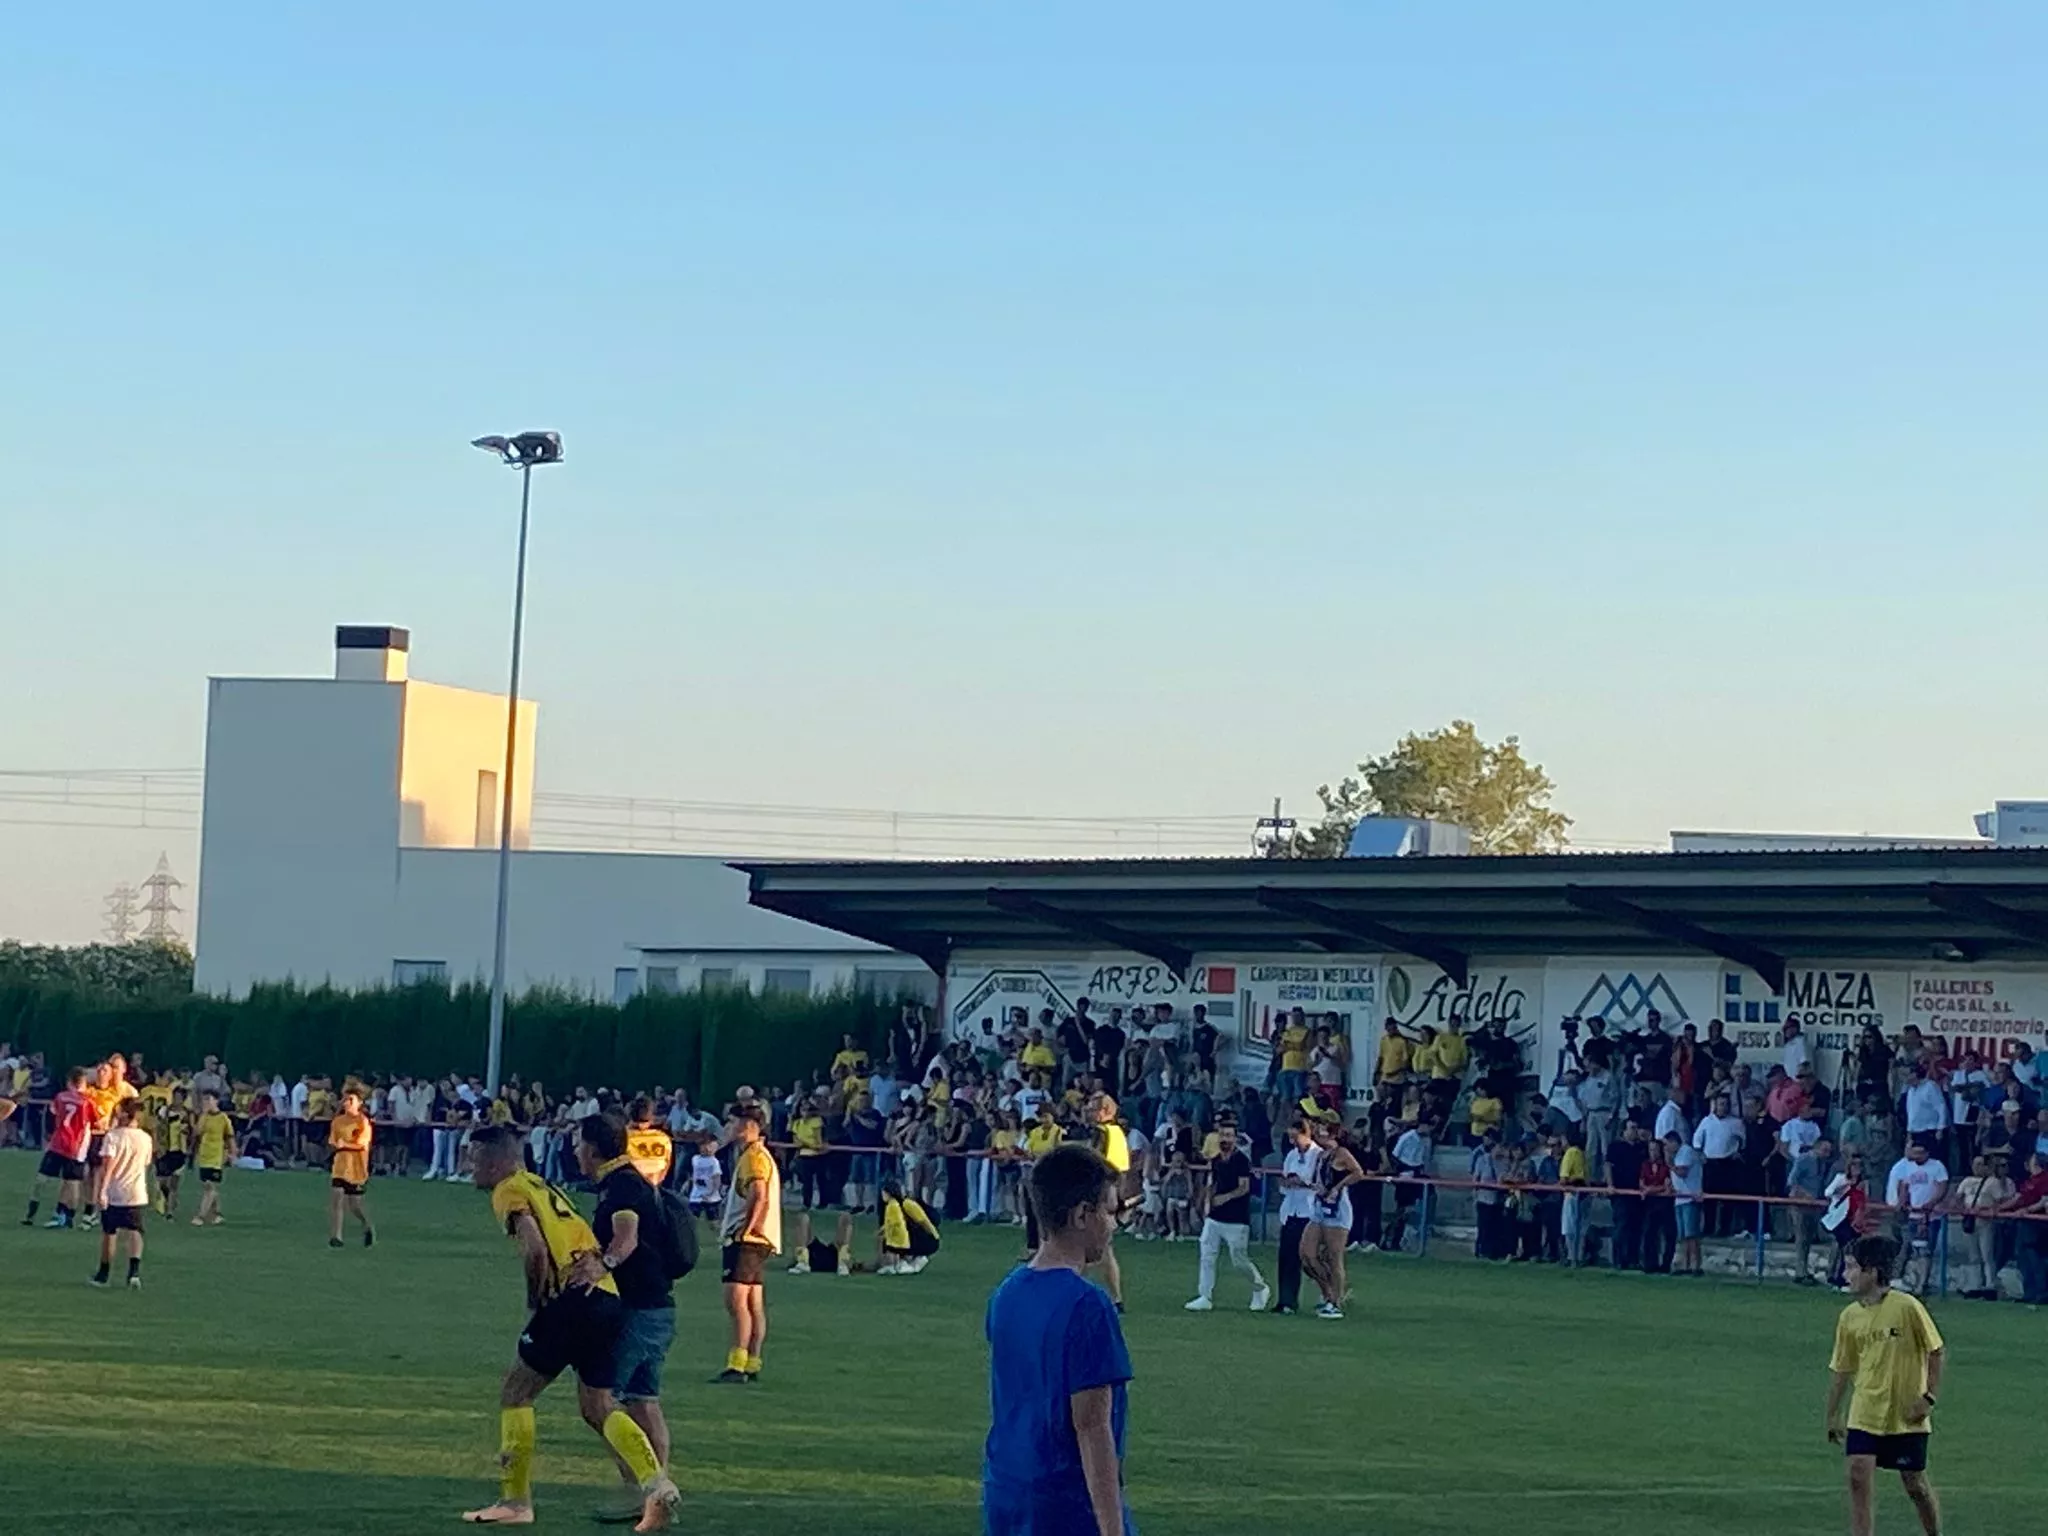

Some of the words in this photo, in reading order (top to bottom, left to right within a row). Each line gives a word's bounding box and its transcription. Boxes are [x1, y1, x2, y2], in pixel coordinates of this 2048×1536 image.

[1786, 971, 1876, 1010] MAZA
[1913, 980, 1995, 995] TALLERES
[63, 1103, 77, 1128] 7
